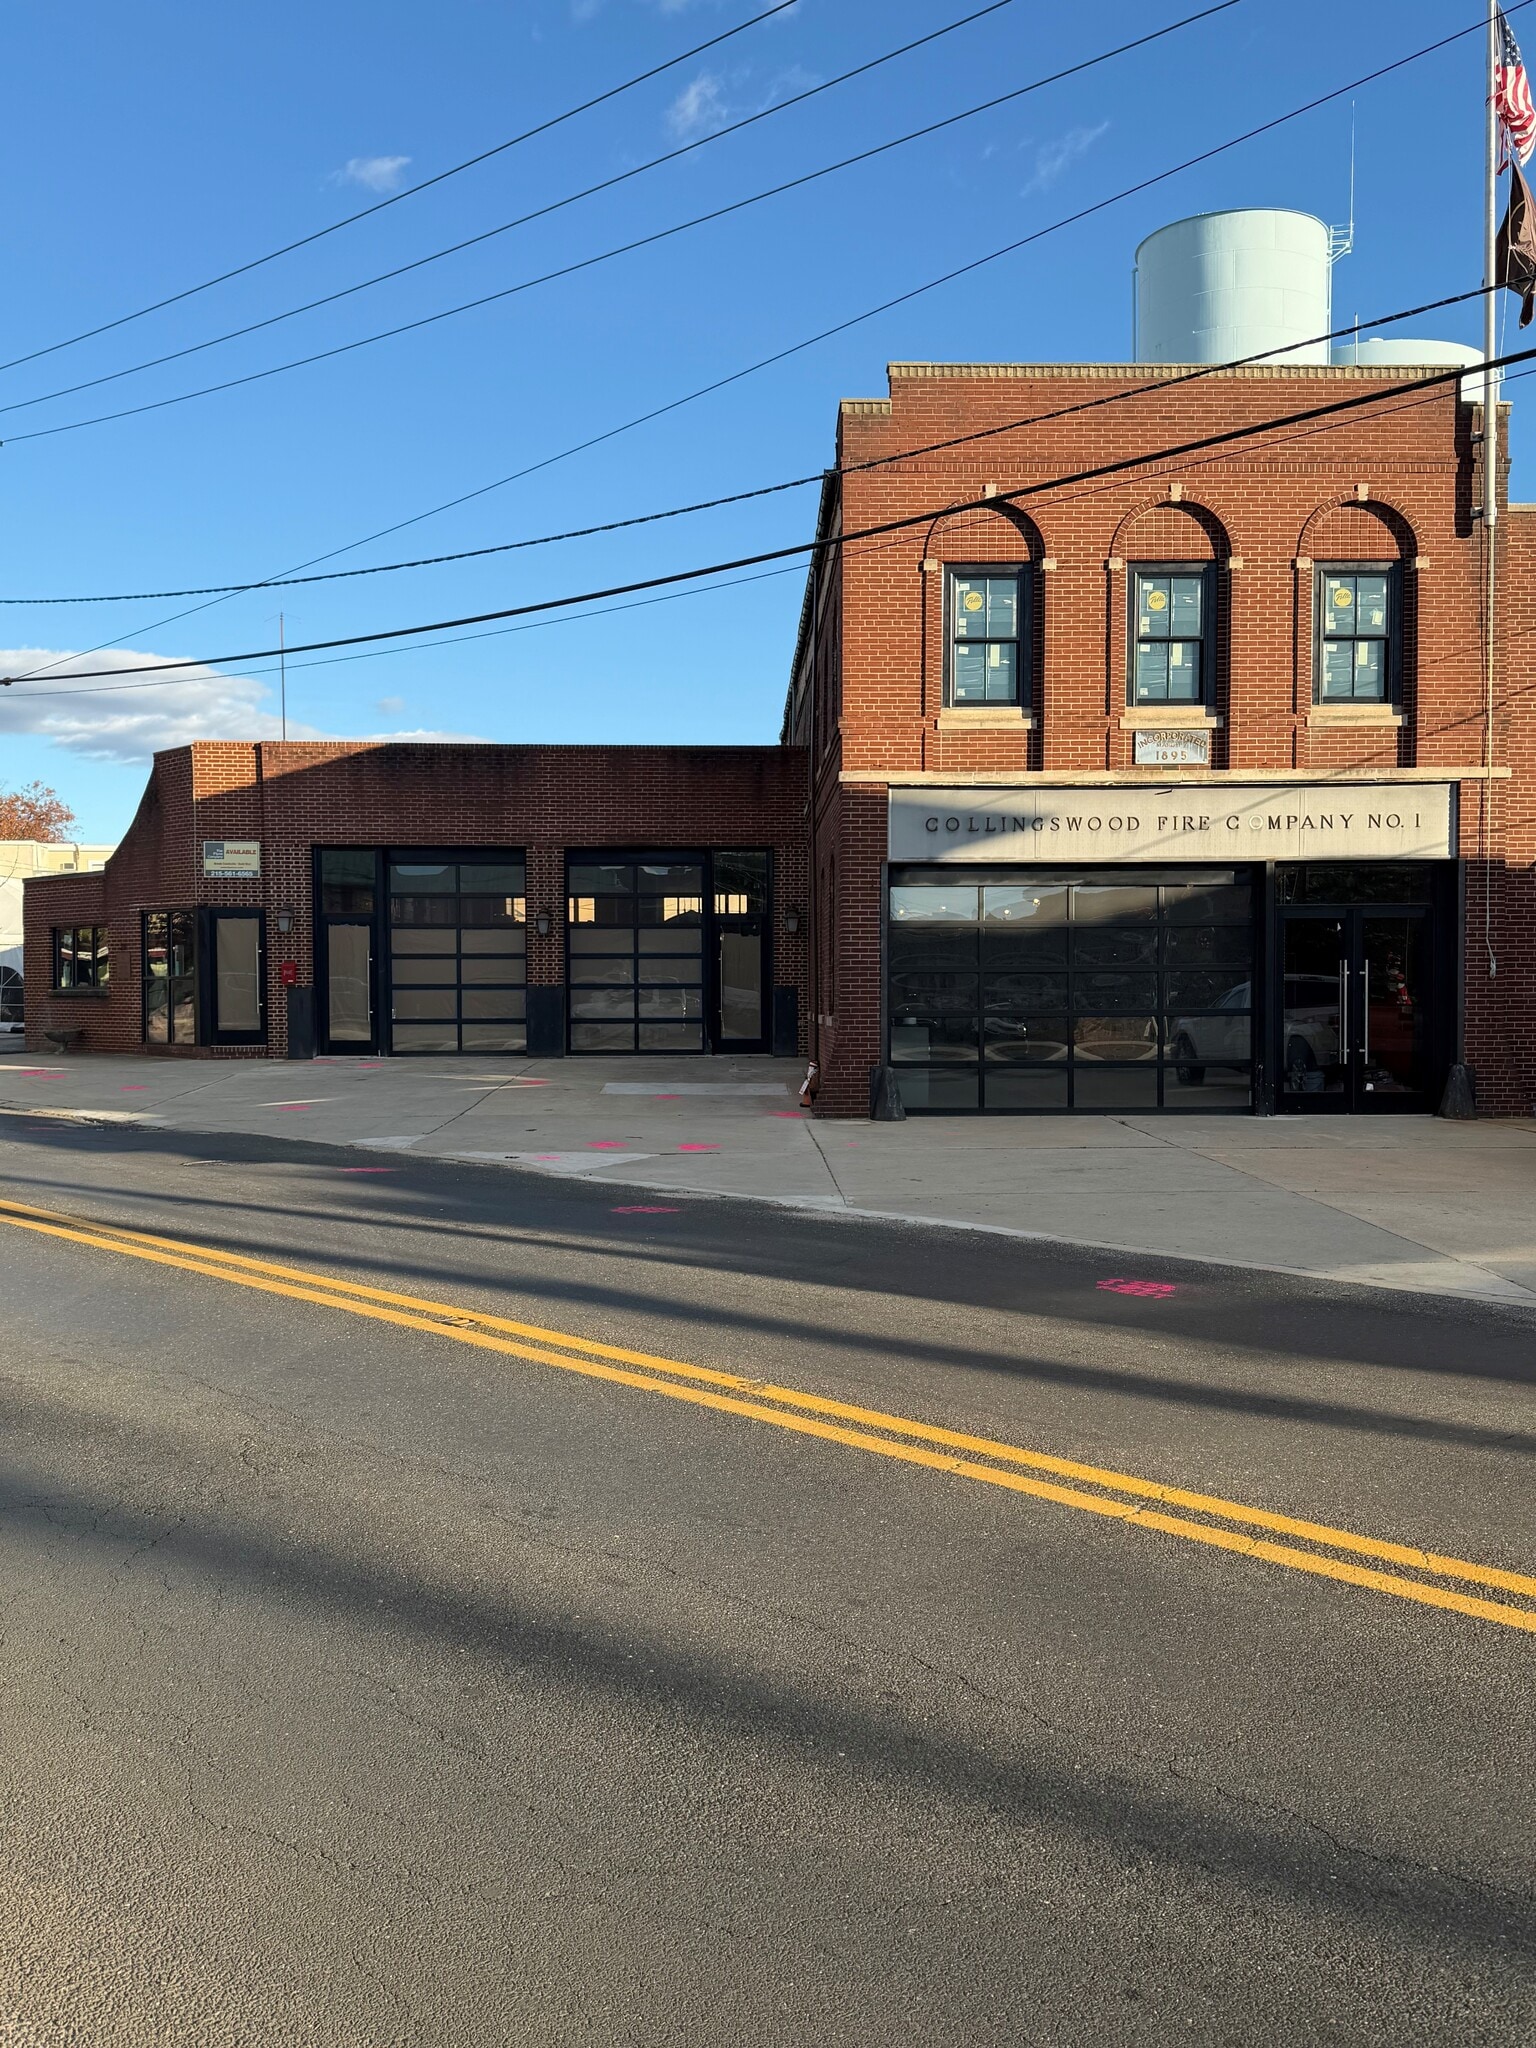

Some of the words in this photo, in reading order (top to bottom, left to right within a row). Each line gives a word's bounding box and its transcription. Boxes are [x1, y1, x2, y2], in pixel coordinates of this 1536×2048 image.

[1137, 731, 1207, 749] INCORPORATED
[1156, 750, 1188, 761] 1895
[925, 816, 1140, 833] COLLINGSWOOD
[1157, 815, 1211, 831] FIRE
[1226, 813, 1355, 831] COMPANY
[1367, 813, 1405, 829] NO.
[1414, 813, 1422, 828] 1
